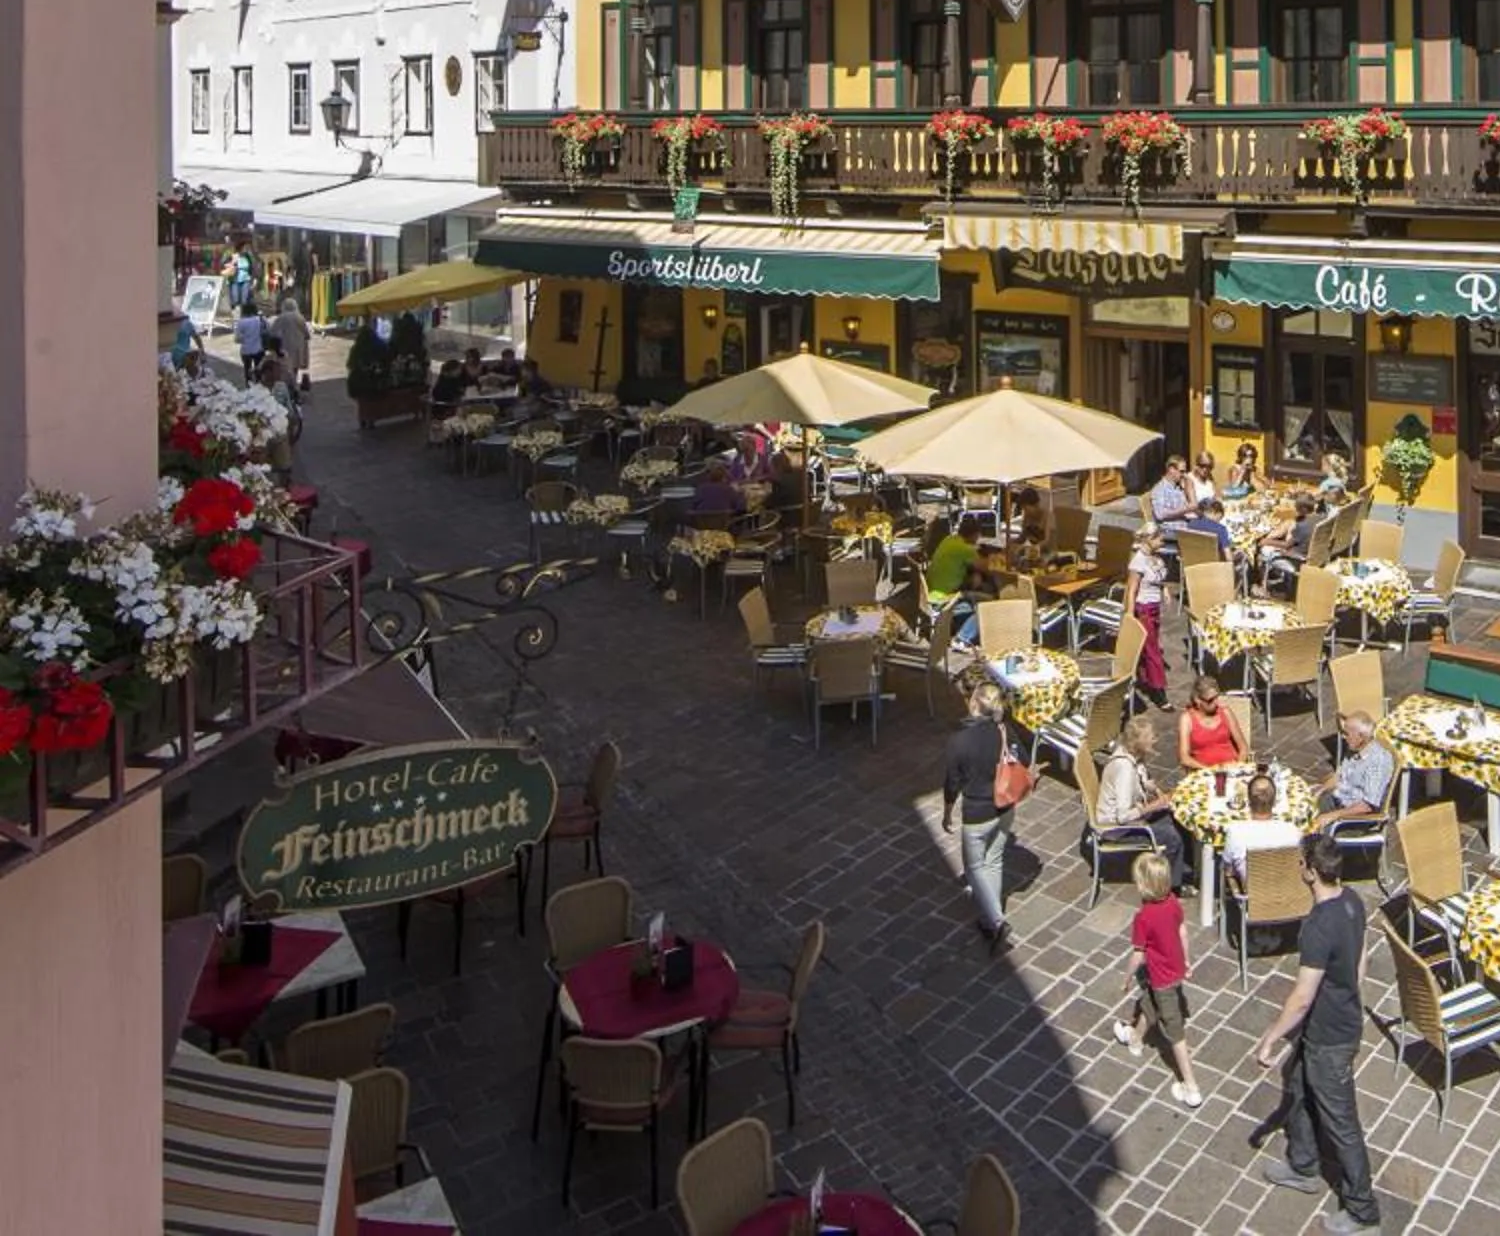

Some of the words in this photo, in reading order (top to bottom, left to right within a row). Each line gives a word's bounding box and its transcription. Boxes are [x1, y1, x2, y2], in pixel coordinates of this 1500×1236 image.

[607, 250, 764, 285] Sportstüberl
[1315, 265, 1387, 309] Café
[261, 788, 531, 882] Feinschmeck
[294, 839, 507, 901] Restaurant-Bar
